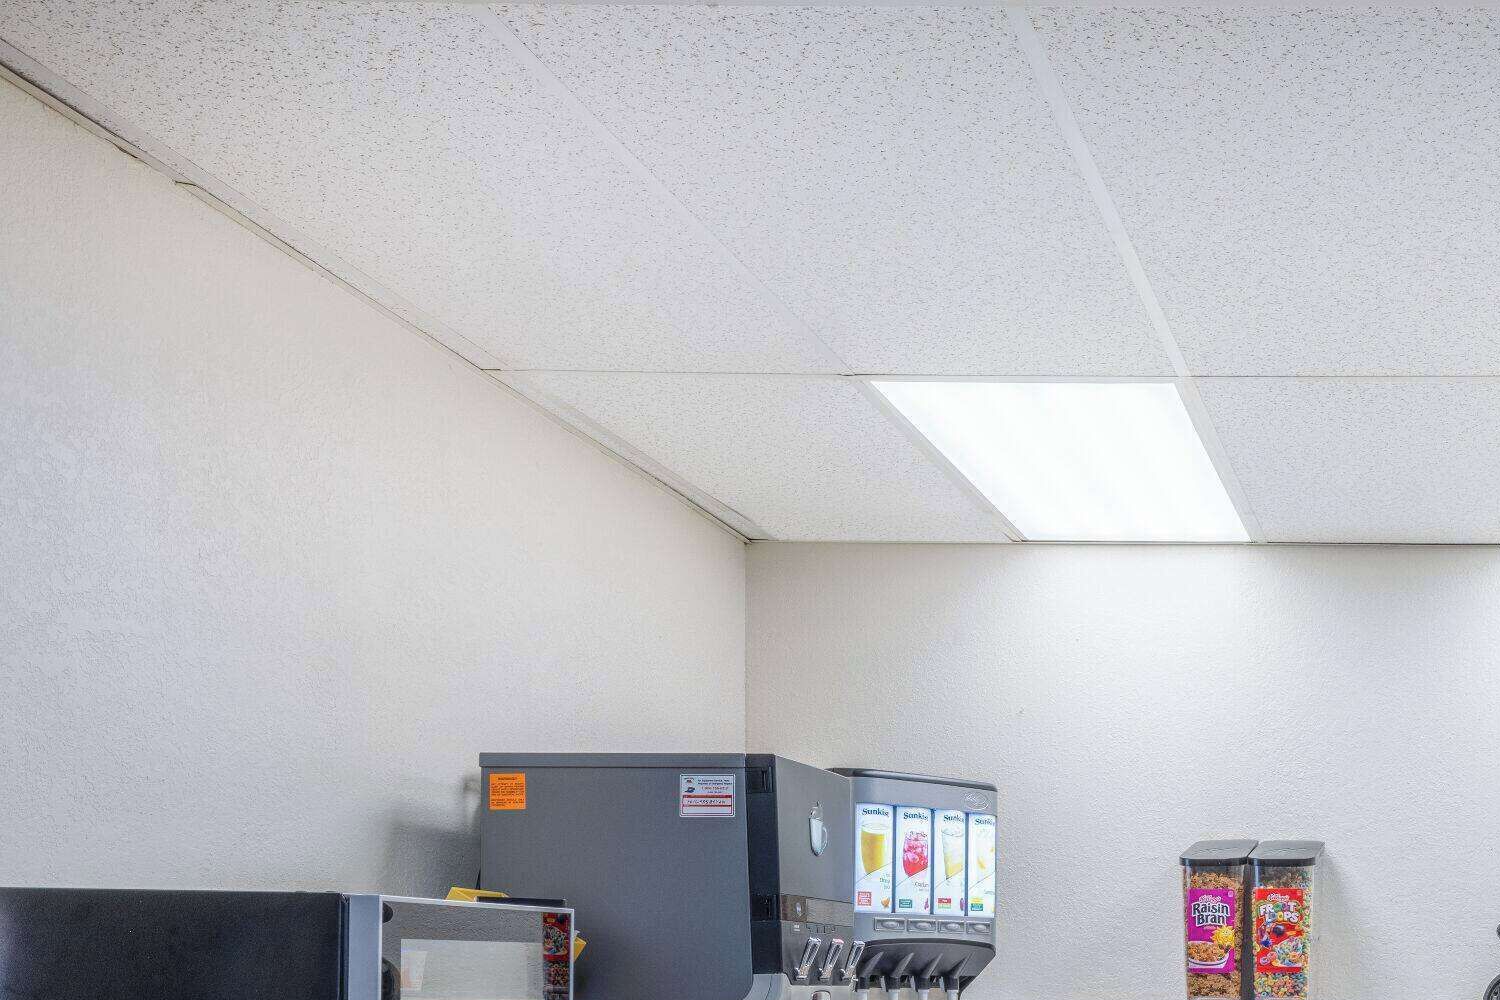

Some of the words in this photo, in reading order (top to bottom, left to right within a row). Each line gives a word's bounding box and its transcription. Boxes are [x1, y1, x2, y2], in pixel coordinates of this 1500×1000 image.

[903, 812, 929, 821] Sunkis
[1192, 902, 1230, 915] Raisin
[1196, 914, 1227, 925] Bran
